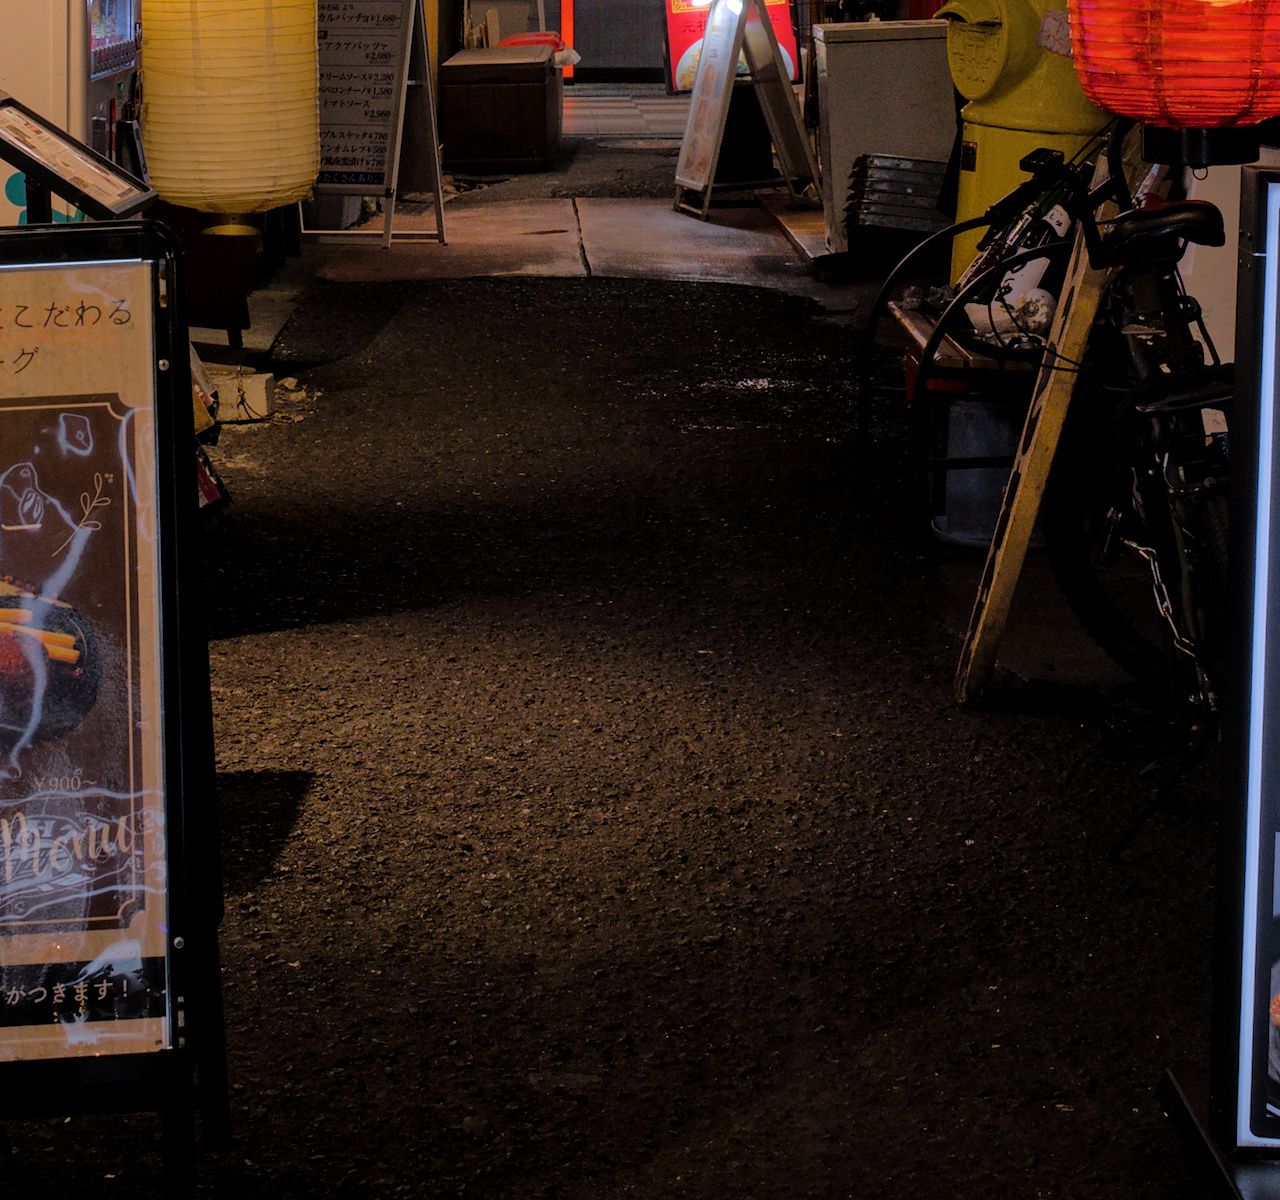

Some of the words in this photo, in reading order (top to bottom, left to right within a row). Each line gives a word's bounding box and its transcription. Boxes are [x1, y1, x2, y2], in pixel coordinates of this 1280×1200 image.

[318, 40, 388, 51] アクアパッツァ
